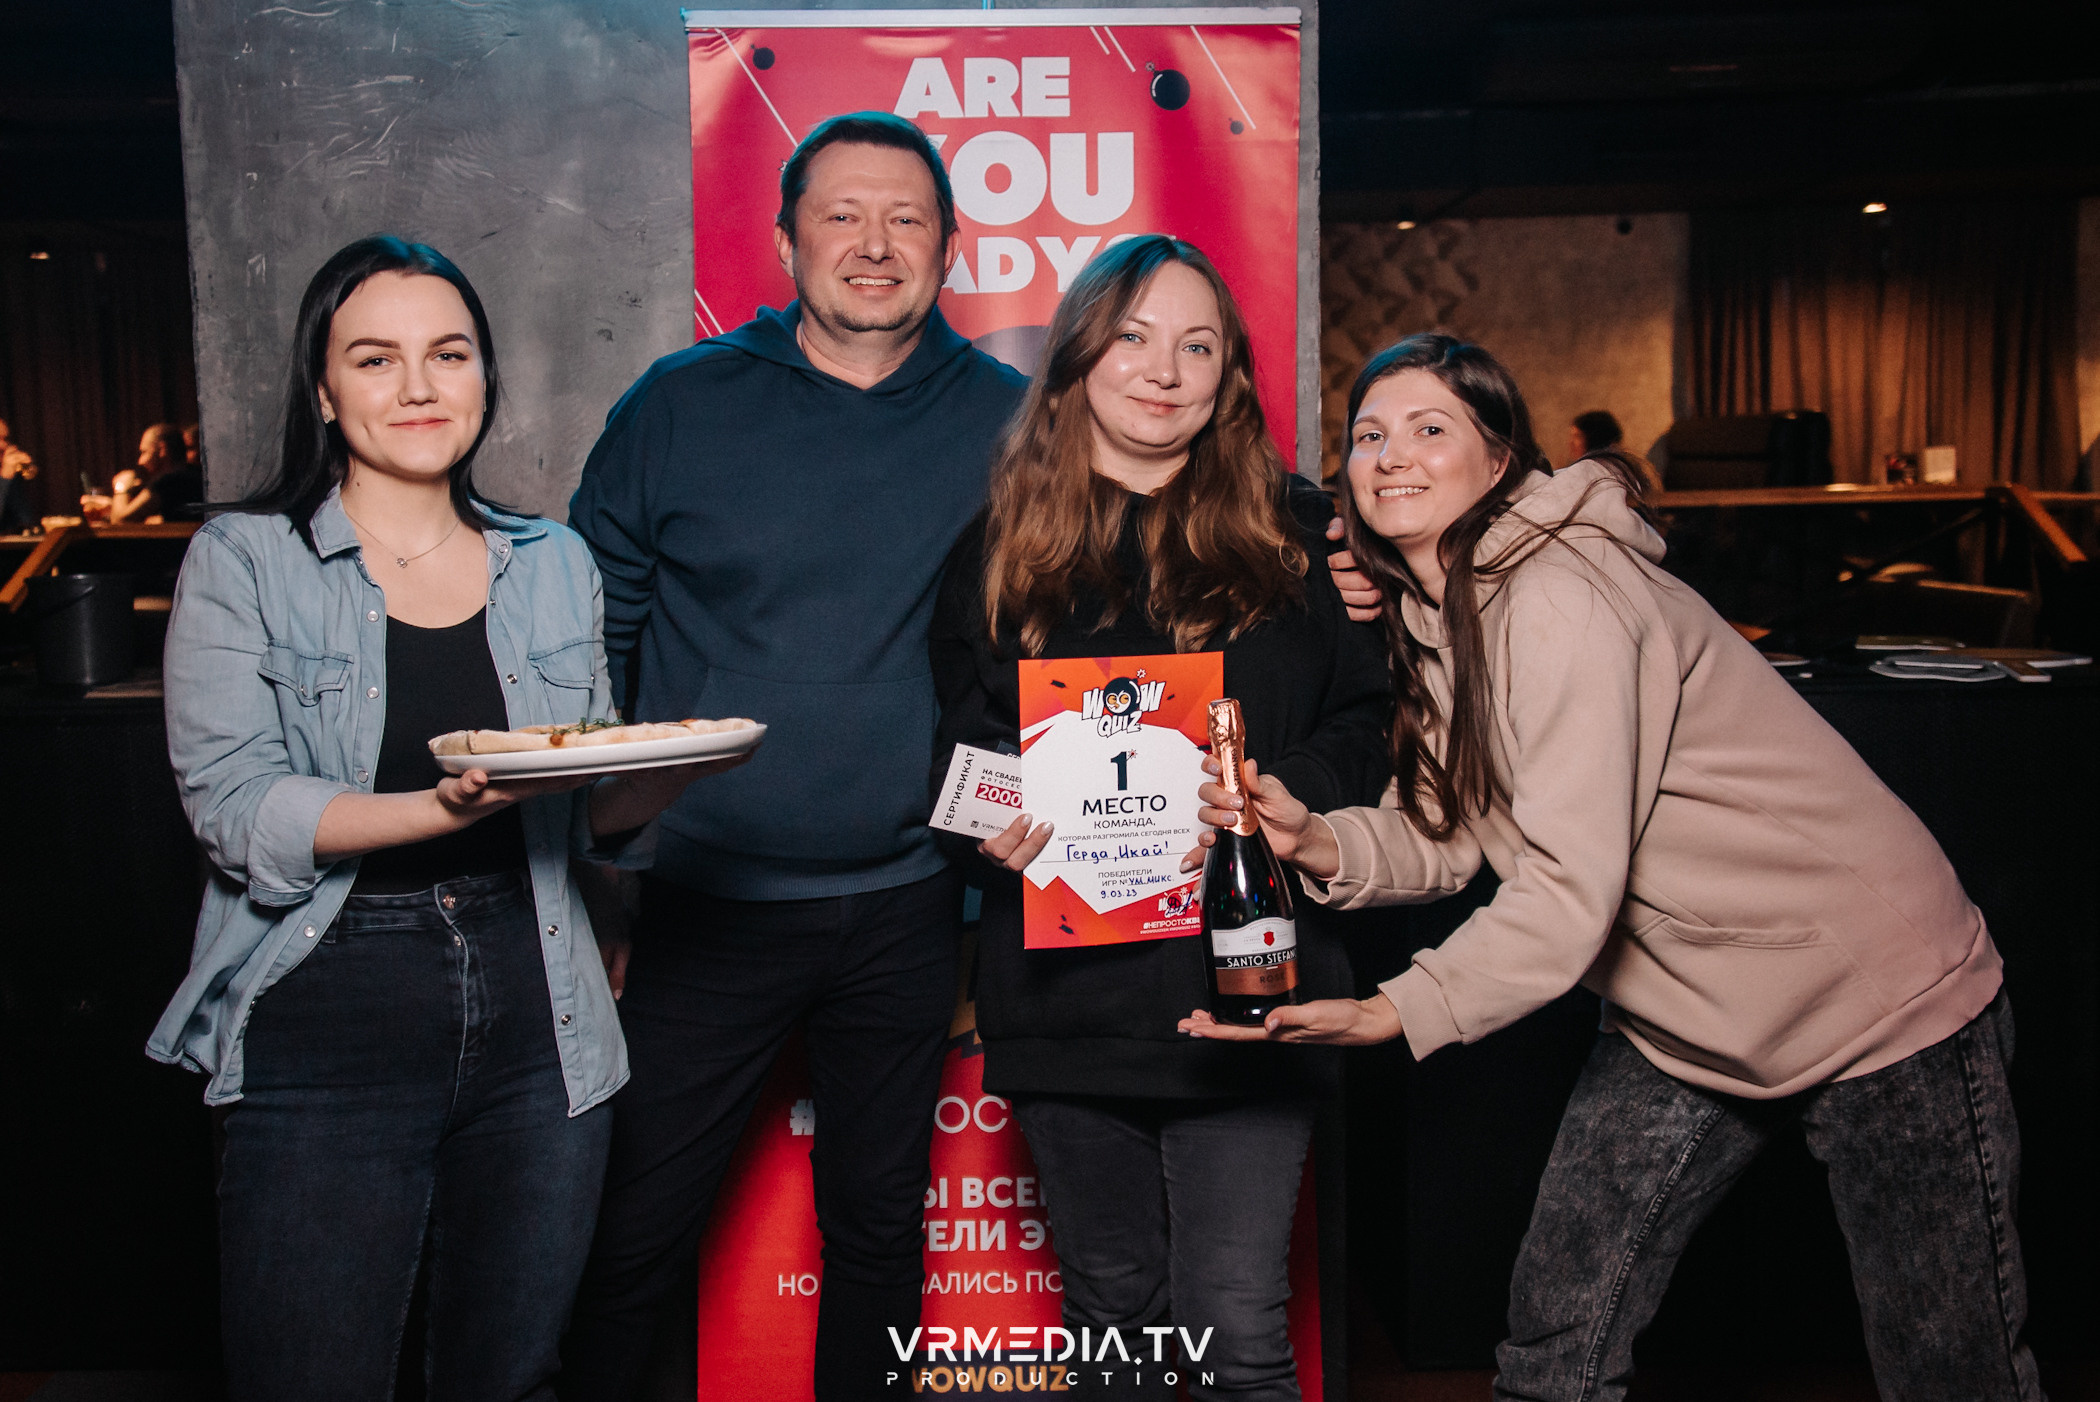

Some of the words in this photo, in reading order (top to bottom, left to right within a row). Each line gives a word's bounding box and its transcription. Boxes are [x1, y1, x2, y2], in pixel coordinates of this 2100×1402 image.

[893, 57, 1070, 118] ARE
[1097, 710, 1142, 738] QUIZ
[982, 768, 993, 777] НА
[1110, 751, 1128, 791] 1
[943, 751, 975, 826] СЕРТИФИКАТ
[1082, 794, 1167, 816] МЕСТО
[1094, 817, 1156, 829] КОМАНДА,
[1058, 833, 1091, 842] КОТОРАЯ
[1092, 831, 1139, 840] РАЗГРОМИЛА
[1140, 829, 1172, 837] СЕГОДНЯ
[1098, 868, 1153, 879] ПОБЕДИТЕЛИ
[1226, 955, 1264, 968] SANTO
[1266, 947, 1297, 964] STEFAN
[923, 1177, 948, 1209] Ы
